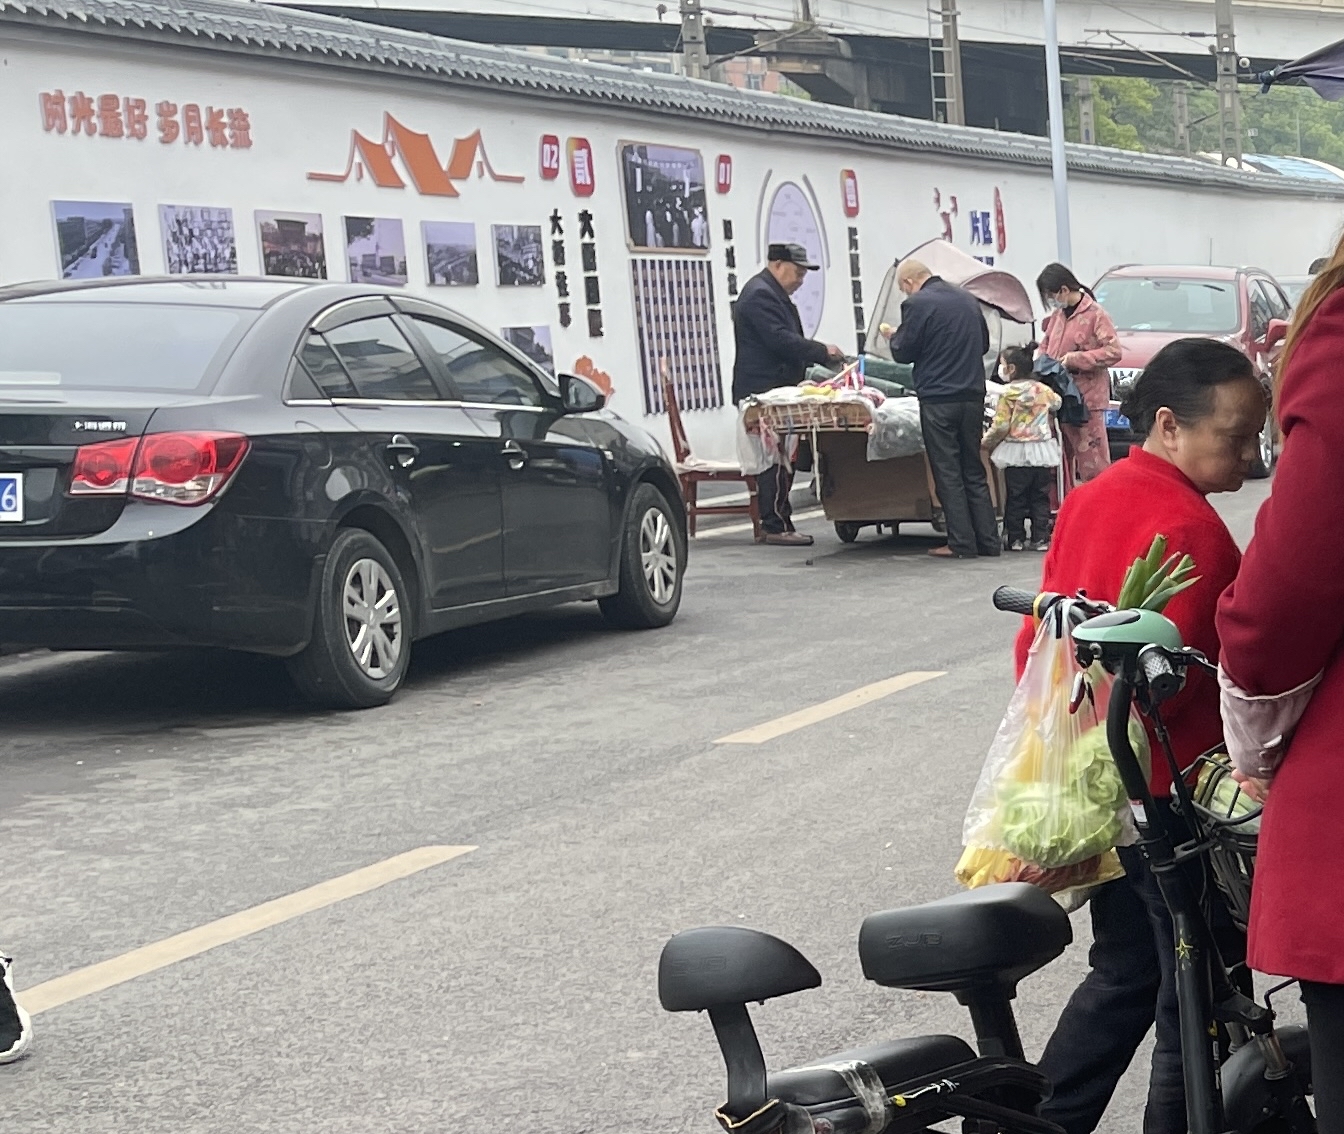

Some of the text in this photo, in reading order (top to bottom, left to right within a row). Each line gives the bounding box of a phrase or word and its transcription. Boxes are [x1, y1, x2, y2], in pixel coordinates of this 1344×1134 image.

[543, 143, 559, 169] 02
[719, 162, 730, 185] 01
[2, 483, 16, 511] 6
